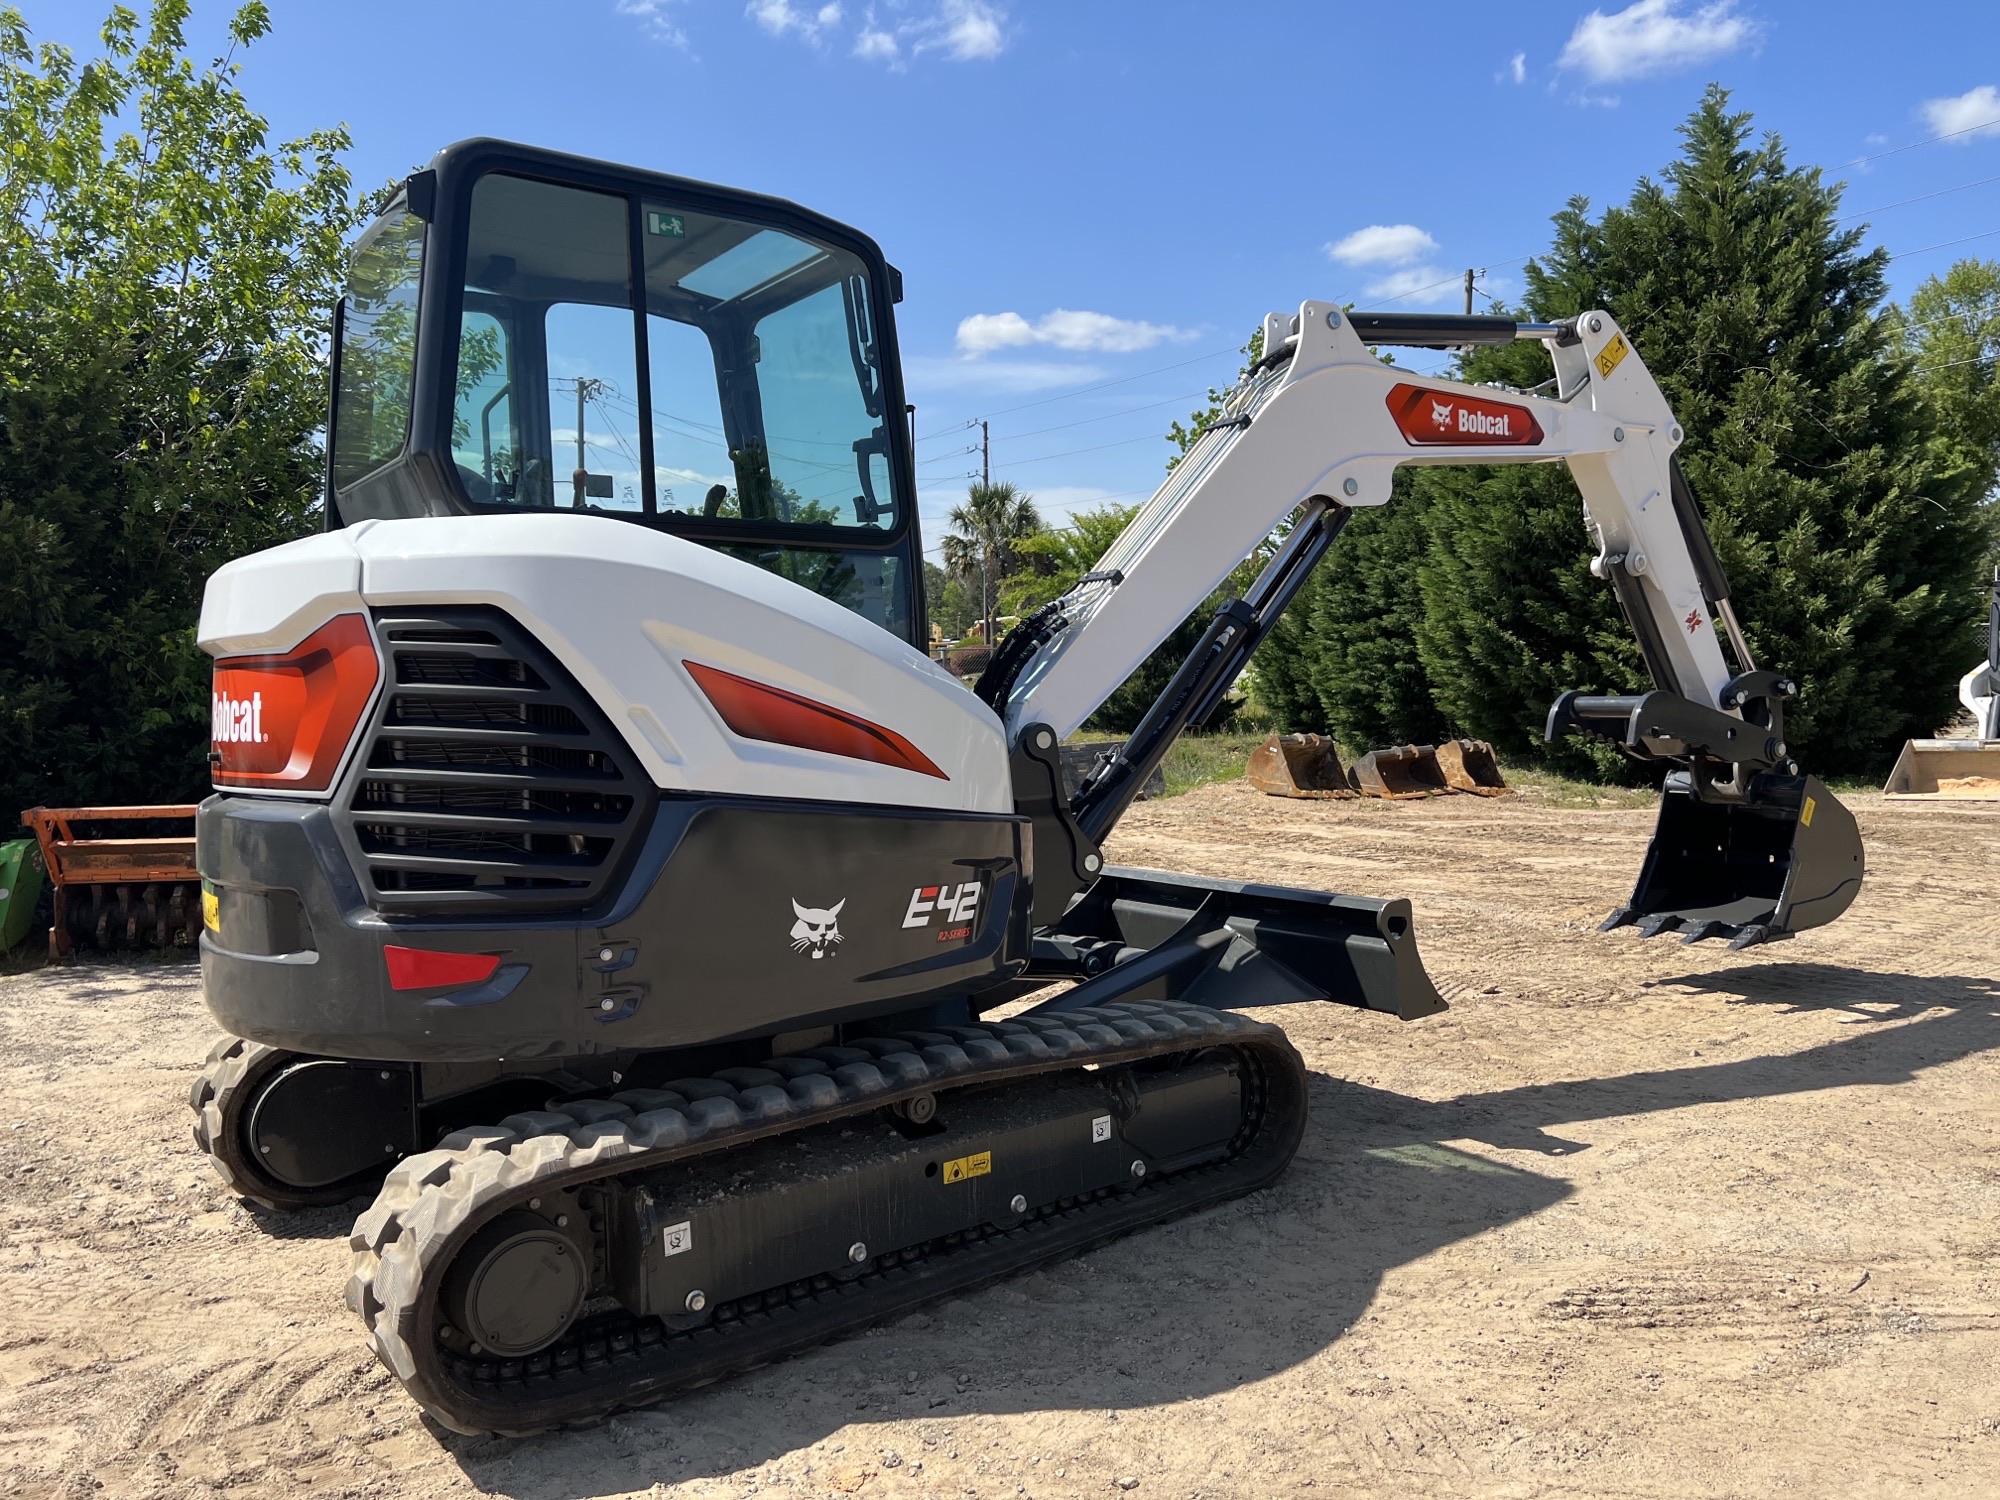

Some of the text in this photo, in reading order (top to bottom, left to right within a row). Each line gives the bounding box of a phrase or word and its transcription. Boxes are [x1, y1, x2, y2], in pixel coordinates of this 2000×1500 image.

[1458, 408, 1509, 436] Bobcat
[212, 691, 262, 743] Bobcat
[902, 881, 981, 929] E42
[937, 926, 971, 941] R2-SERIES
